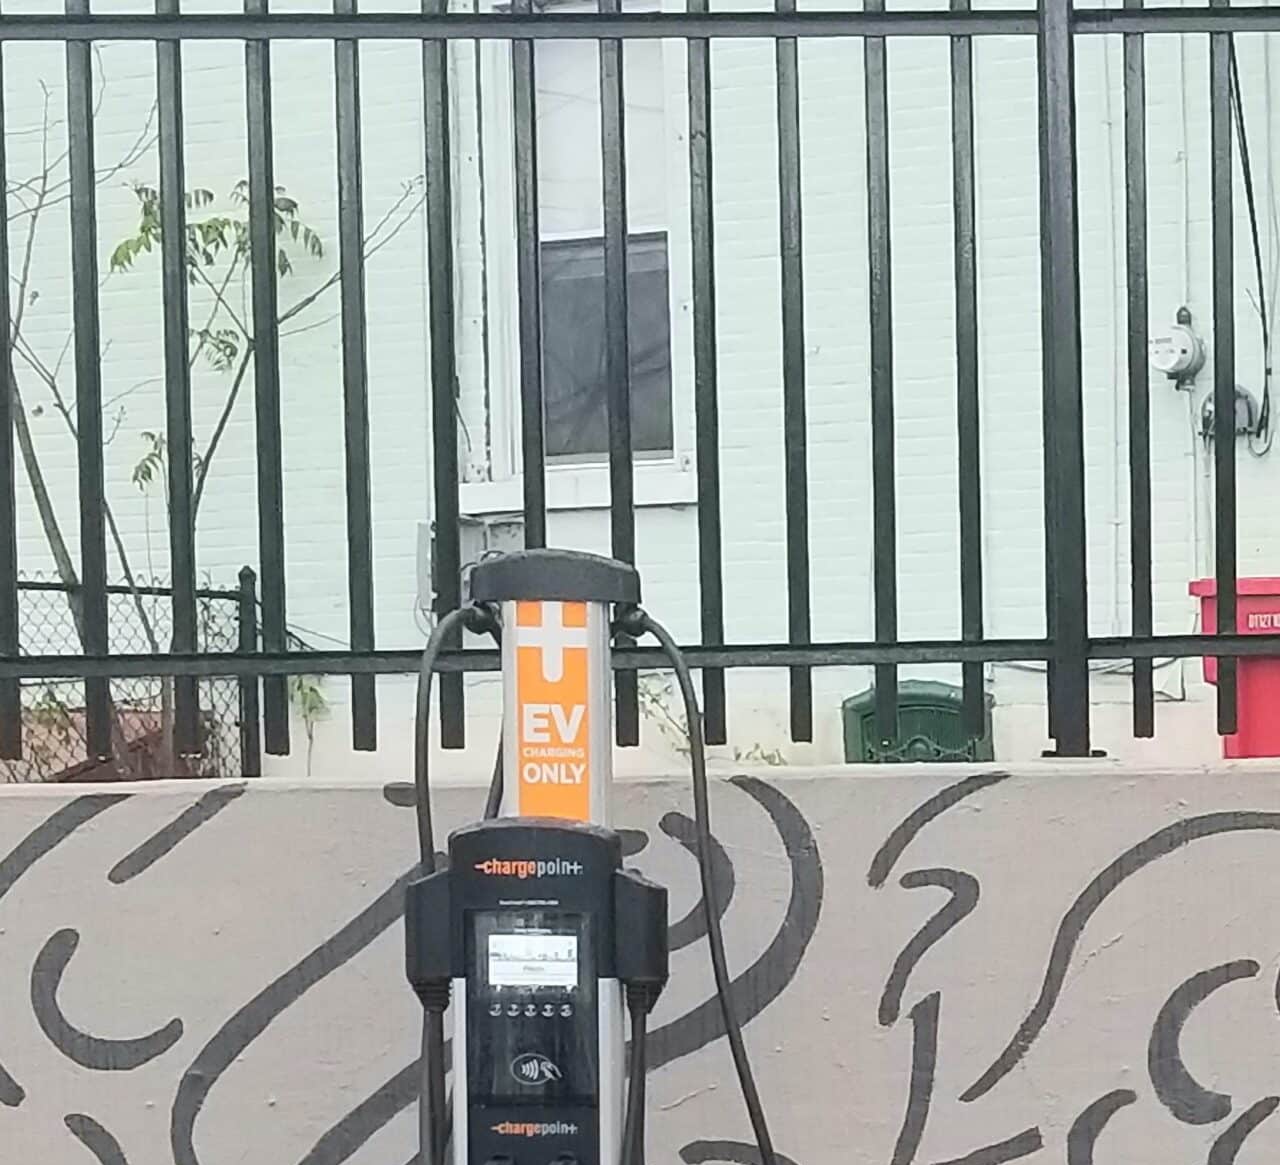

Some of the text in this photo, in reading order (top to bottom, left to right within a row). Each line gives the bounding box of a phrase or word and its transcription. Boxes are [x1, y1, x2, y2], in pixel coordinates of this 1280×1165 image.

[522, 703, 586, 744] EV
[522, 747, 585, 759] CHARGING
[522, 762, 587, 785] ONLY
